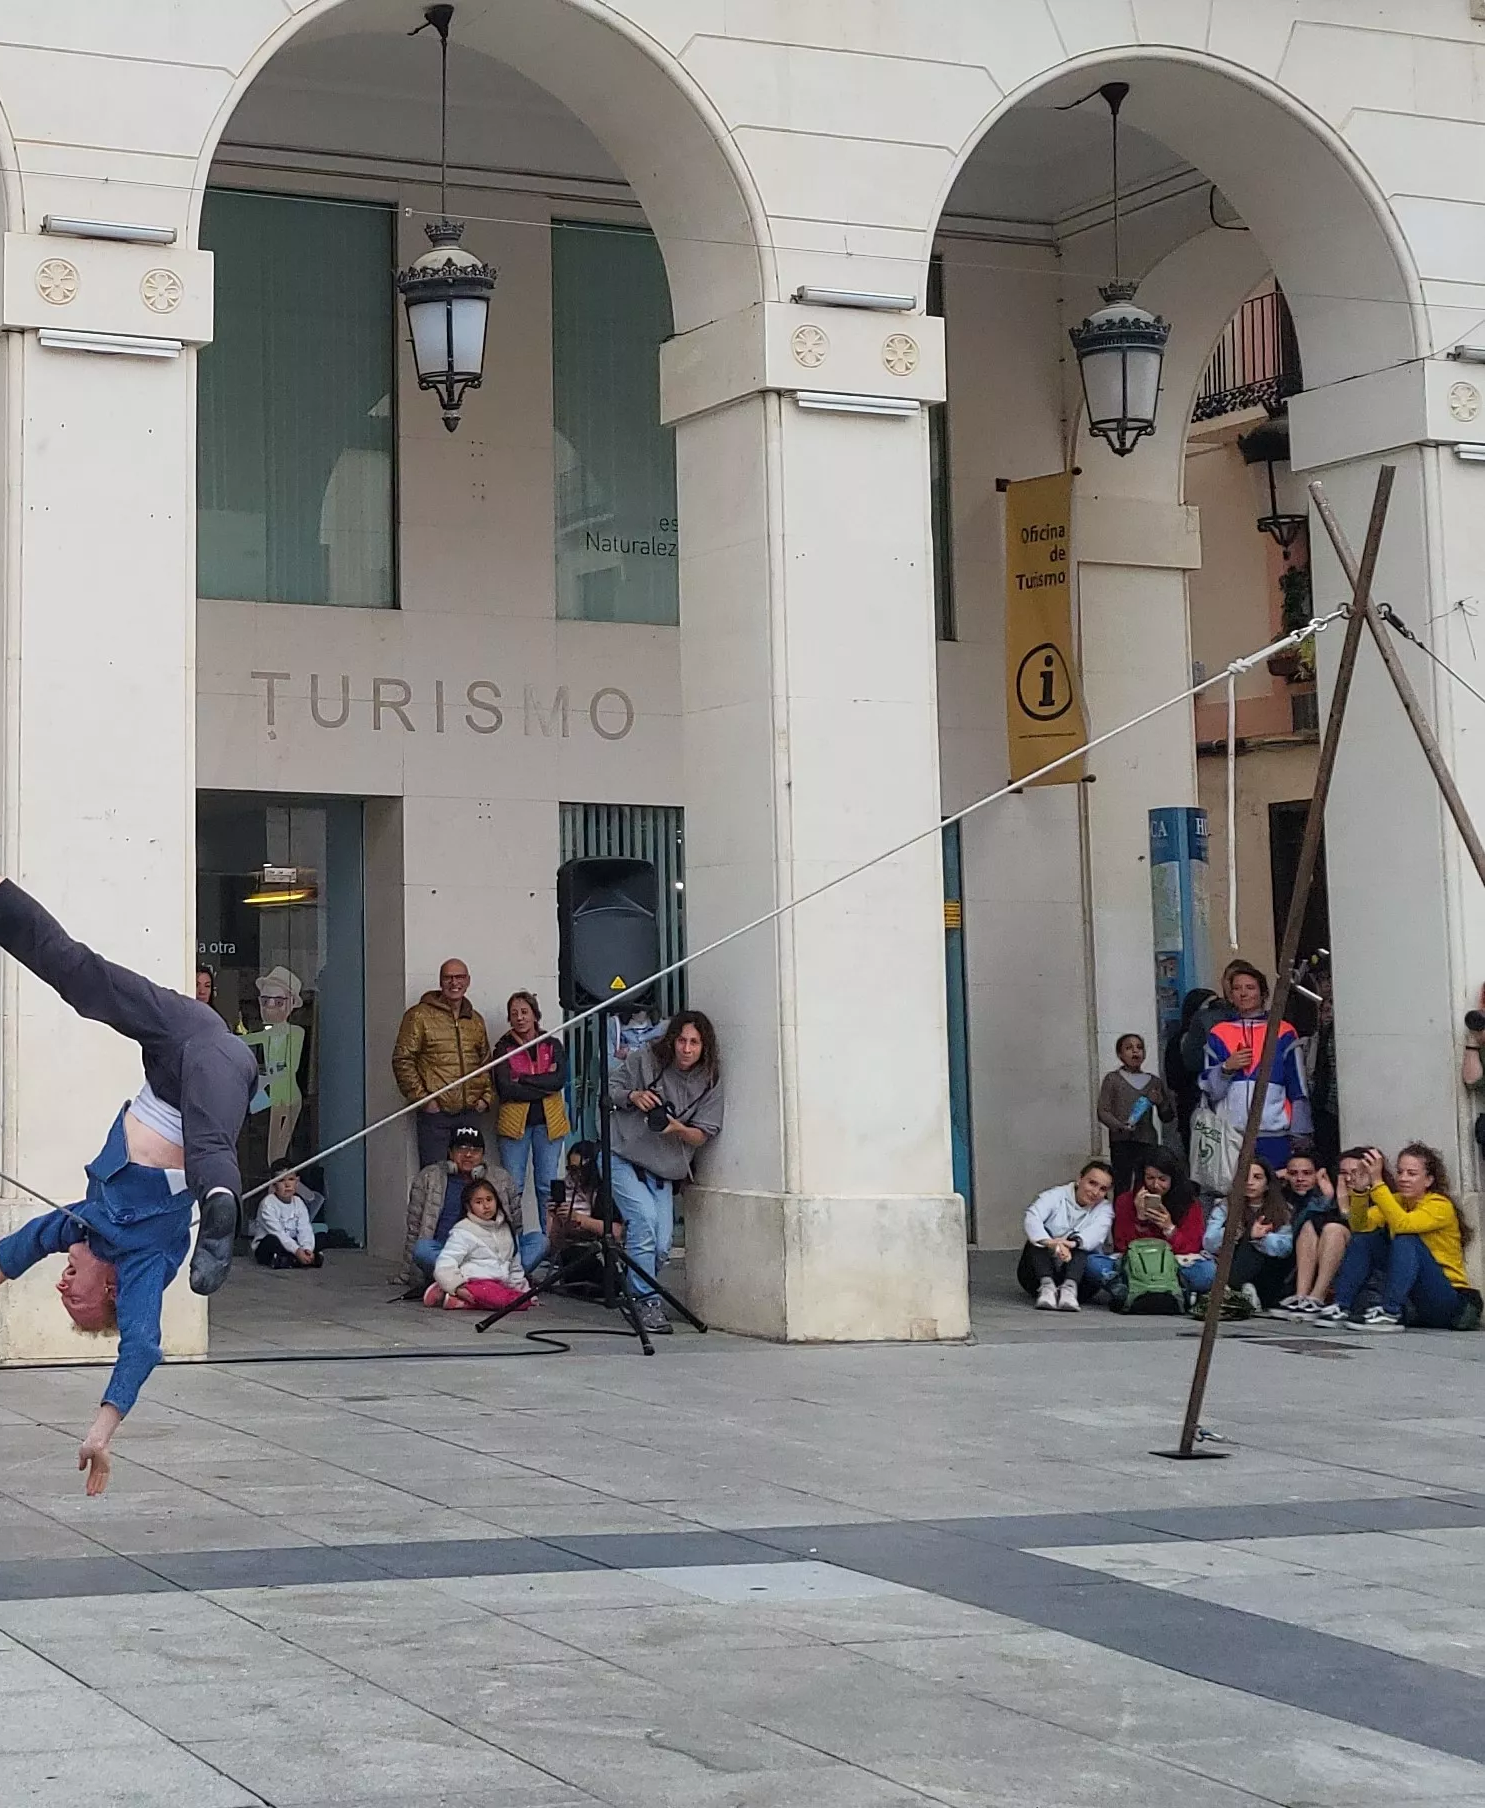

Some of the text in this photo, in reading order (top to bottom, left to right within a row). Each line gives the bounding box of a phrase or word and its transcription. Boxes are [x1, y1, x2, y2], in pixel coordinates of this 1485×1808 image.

[1021, 524, 1065, 544] Oficina
[1050, 544, 1066, 562] de
[251, 671, 634, 740] TURISMO
[210, 941, 236, 954] otra
